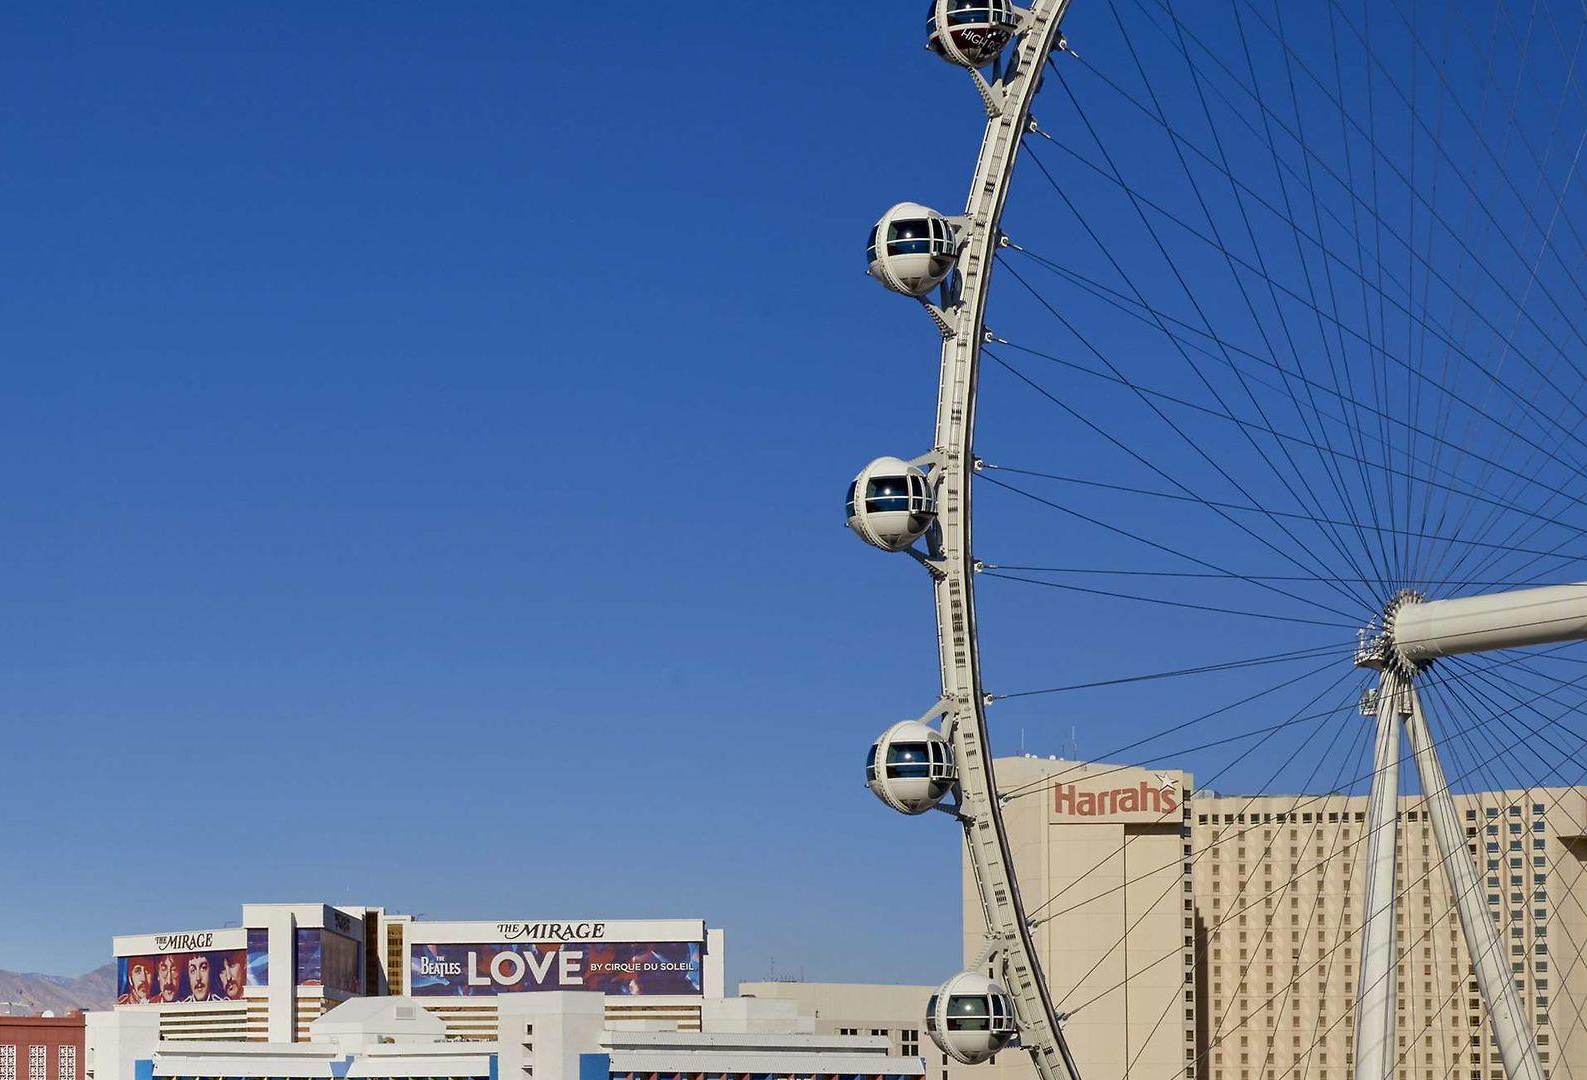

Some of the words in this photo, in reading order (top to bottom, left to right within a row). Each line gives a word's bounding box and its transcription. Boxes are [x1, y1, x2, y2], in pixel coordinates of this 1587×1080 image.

[961, 29, 988, 47] HIGH
[497, 924, 519, 932] THE
[505, 923, 605, 941] MIRAGE
[155, 936, 168, 944] THE
[159, 933, 213, 950] MIRAGE
[420, 956, 462, 978] BEATLES
[468, 951, 583, 985] LOVE
[590, 963, 602, 971] BY
[604, 963, 641, 973] CIRQUE
[643, 963, 658, 971] DU
[660, 962, 694, 971] SOLEIL
